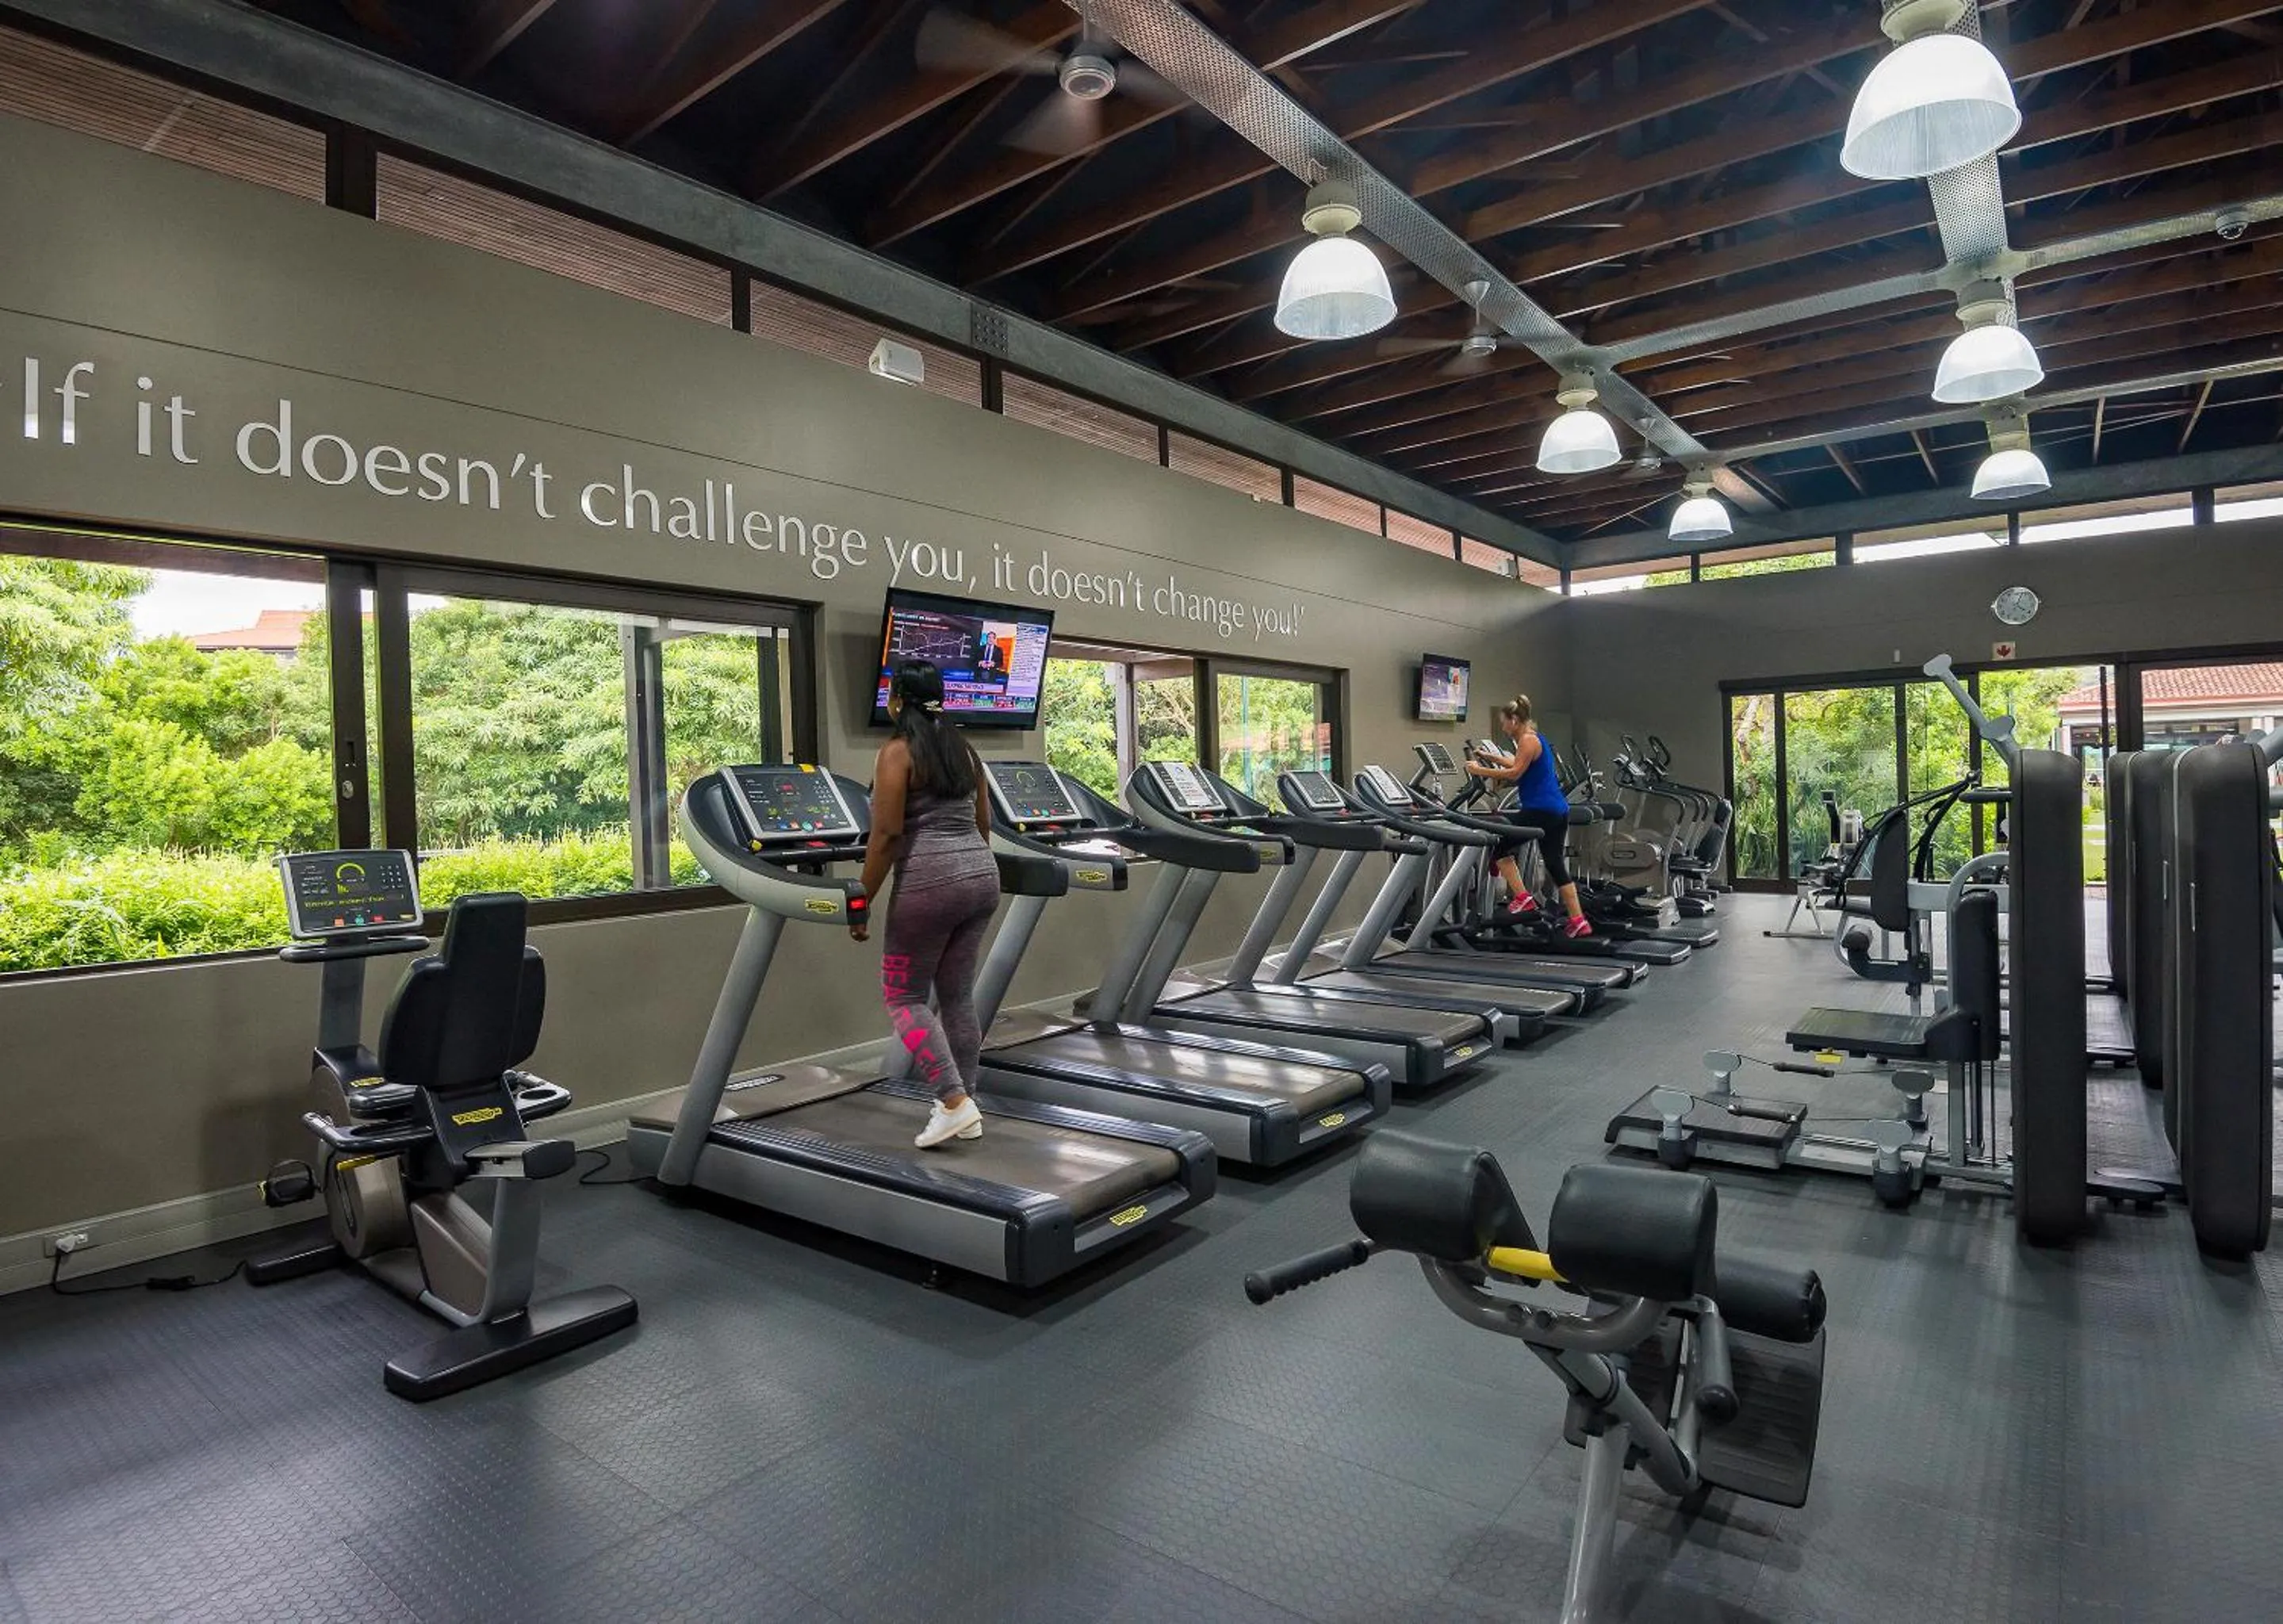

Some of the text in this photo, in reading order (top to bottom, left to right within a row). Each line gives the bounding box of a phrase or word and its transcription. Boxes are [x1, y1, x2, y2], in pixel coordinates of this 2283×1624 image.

[24, 357, 94, 446] If
[136, 377, 199, 463] it
[236, 399, 556, 519] doesn't
[580, 463, 867, 580] challenge
[884, 535, 976, 595] you,
[993, 542, 1017, 592] it
[1028, 550, 1145, 611] doesn't
[1153, 576, 1244, 638] change
